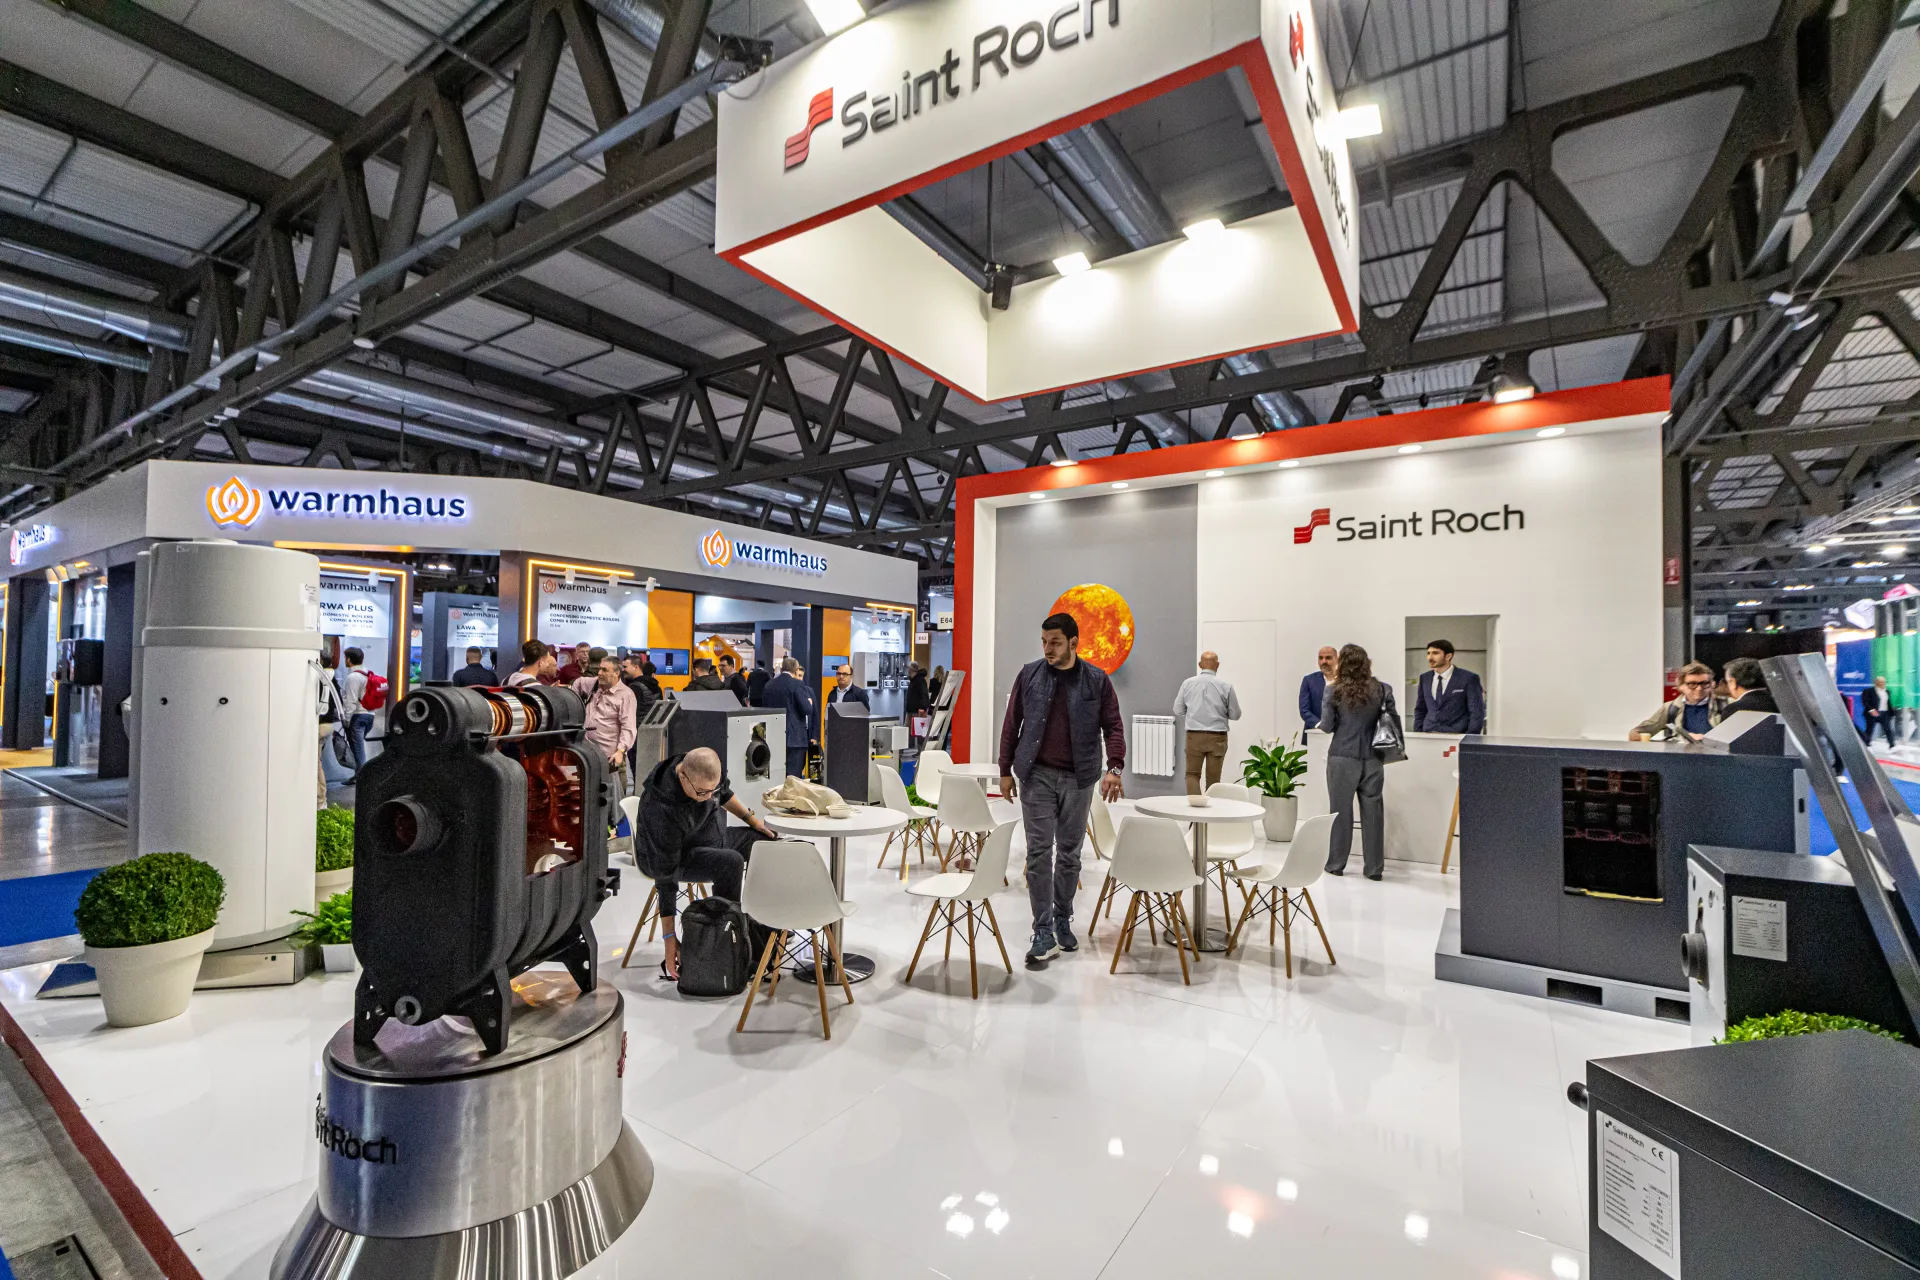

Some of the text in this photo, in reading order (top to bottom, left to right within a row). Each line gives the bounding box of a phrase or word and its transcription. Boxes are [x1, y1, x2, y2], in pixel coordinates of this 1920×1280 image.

[841, 0, 1119, 148] Saint Roch
[268, 488, 467, 518] warmhaus
[1336, 504, 1525, 542] Saint Roch
[735, 541, 828, 572] warmhaus
[558, 582, 607, 595] warmhaus
[347, 604, 374, 612] PLUS
[549, 602, 593, 613] MINERWA
[940, 616, 953, 624] E64
[330, 1123, 397, 1165] Roch
[1612, 1125, 1645, 1148] Saint Roch
